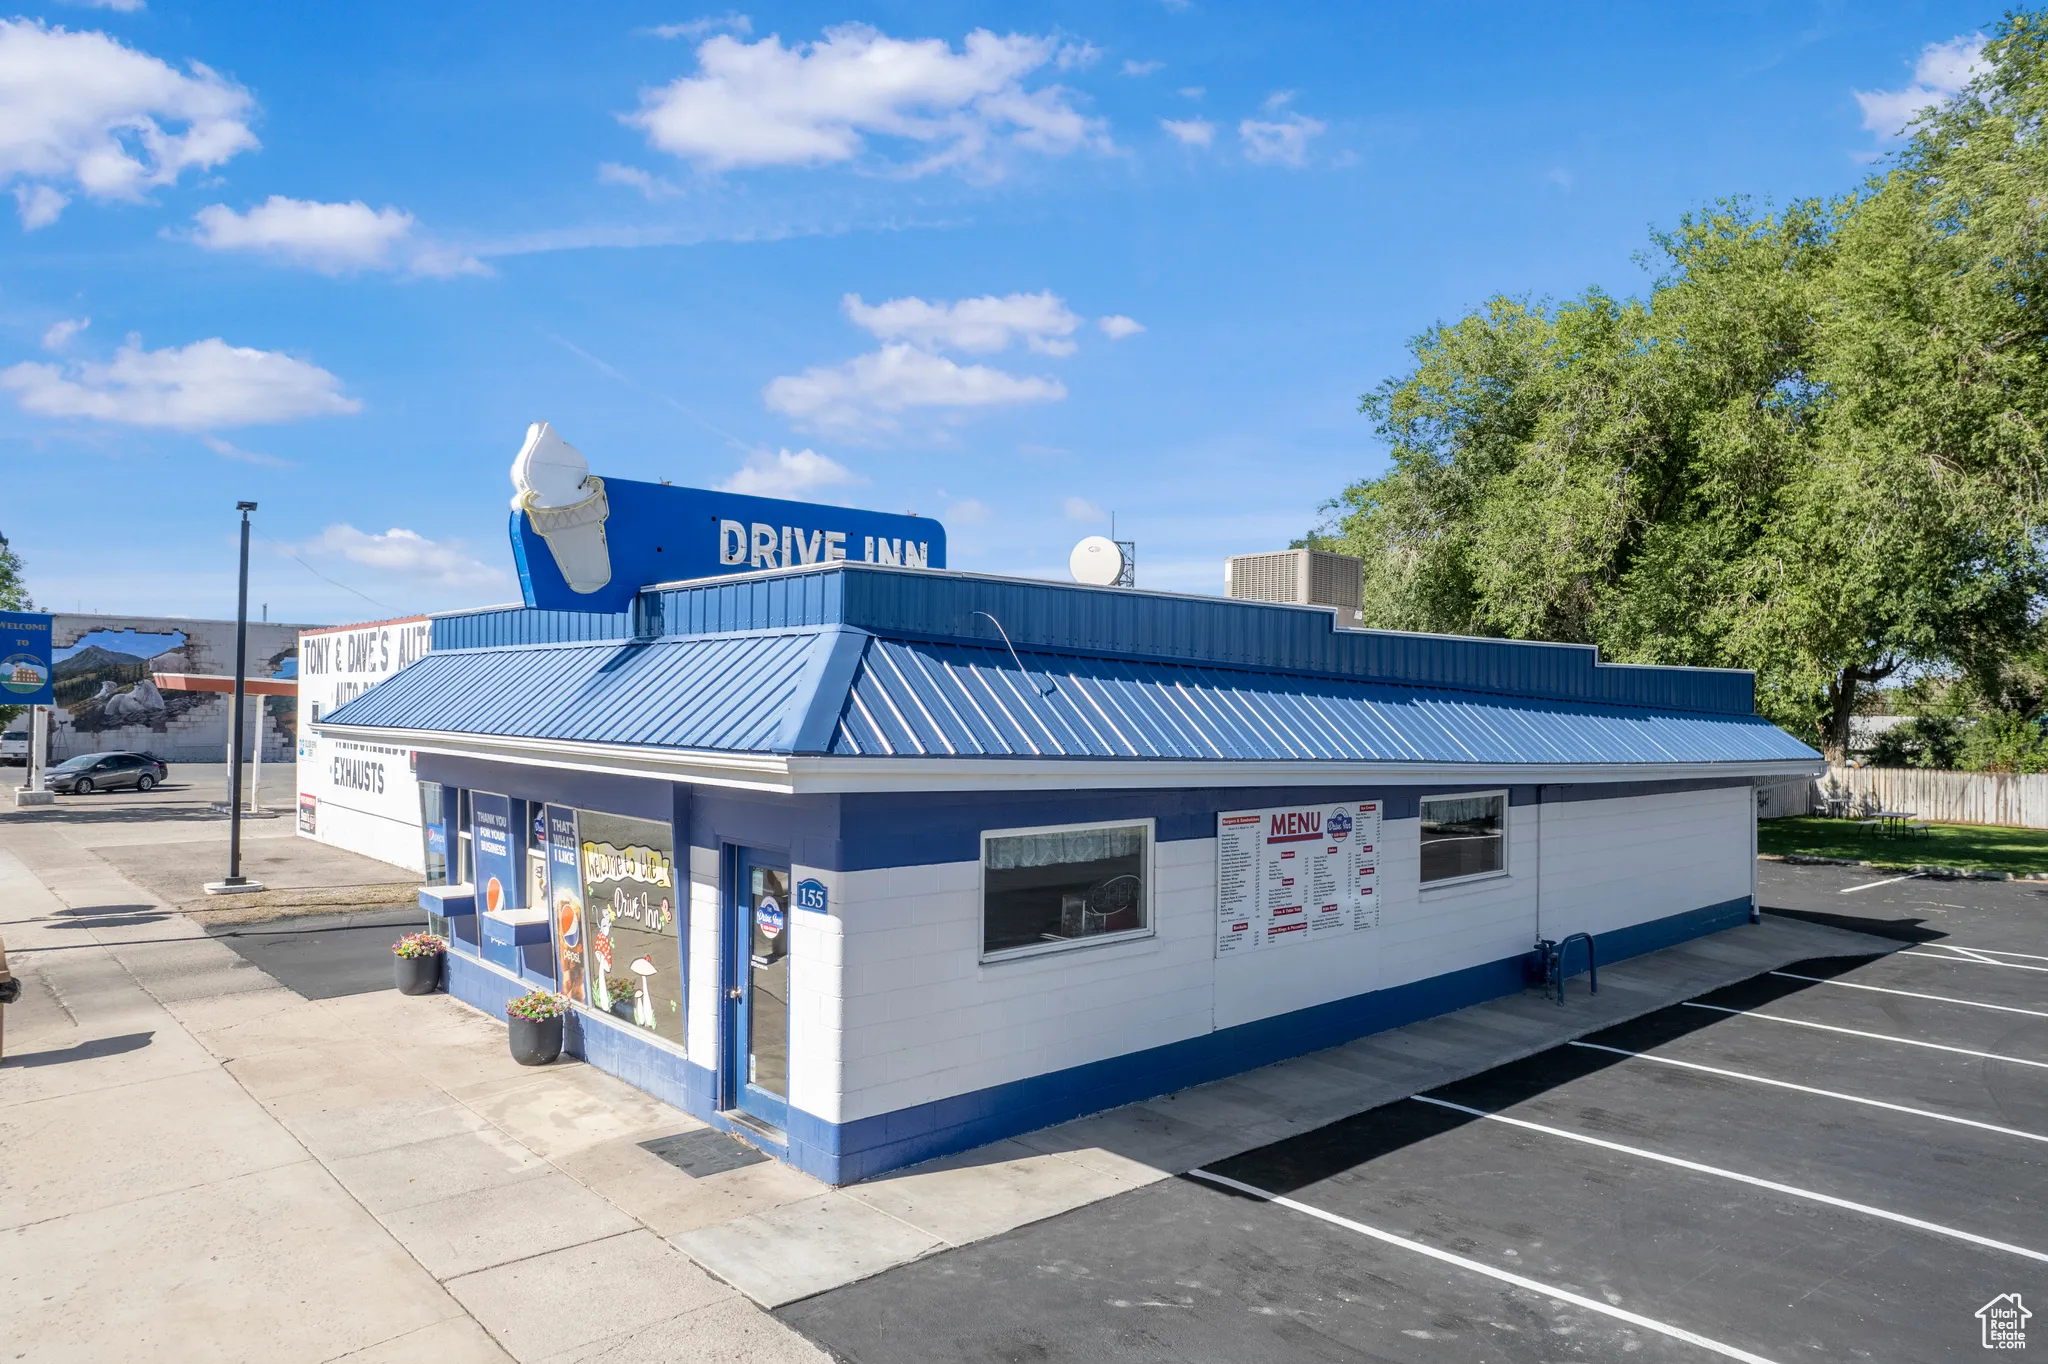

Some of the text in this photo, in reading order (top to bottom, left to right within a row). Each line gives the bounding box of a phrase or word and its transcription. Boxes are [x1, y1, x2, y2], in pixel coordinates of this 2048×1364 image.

[720, 519, 928, 568] DRIVE INN
[0, 621, 48, 631] WELCOME
[16, 639, 29, 647] TO
[304, 637, 331, 675] TONY
[336, 637, 342, 672] &
[348, 626, 389, 673] DAVE'S
[334, 756, 384, 795] EXHAUSTS
[477, 811, 507, 828] THANK YOU
[1271, 811, 1321, 836] MENU
[1328, 820, 1342, 831] Drive
[480, 827, 506, 842] FOR YOUR
[553, 834, 574, 850] WHAT
[481, 840, 506, 857] BUSINESS
[554, 849, 575, 866] I LIKE
[586, 846, 657, 879] Welcome to the
[801, 888, 824, 908] 155
[614, 887, 662, 933] Drive Inn
[564, 949, 581, 964] pepsi
